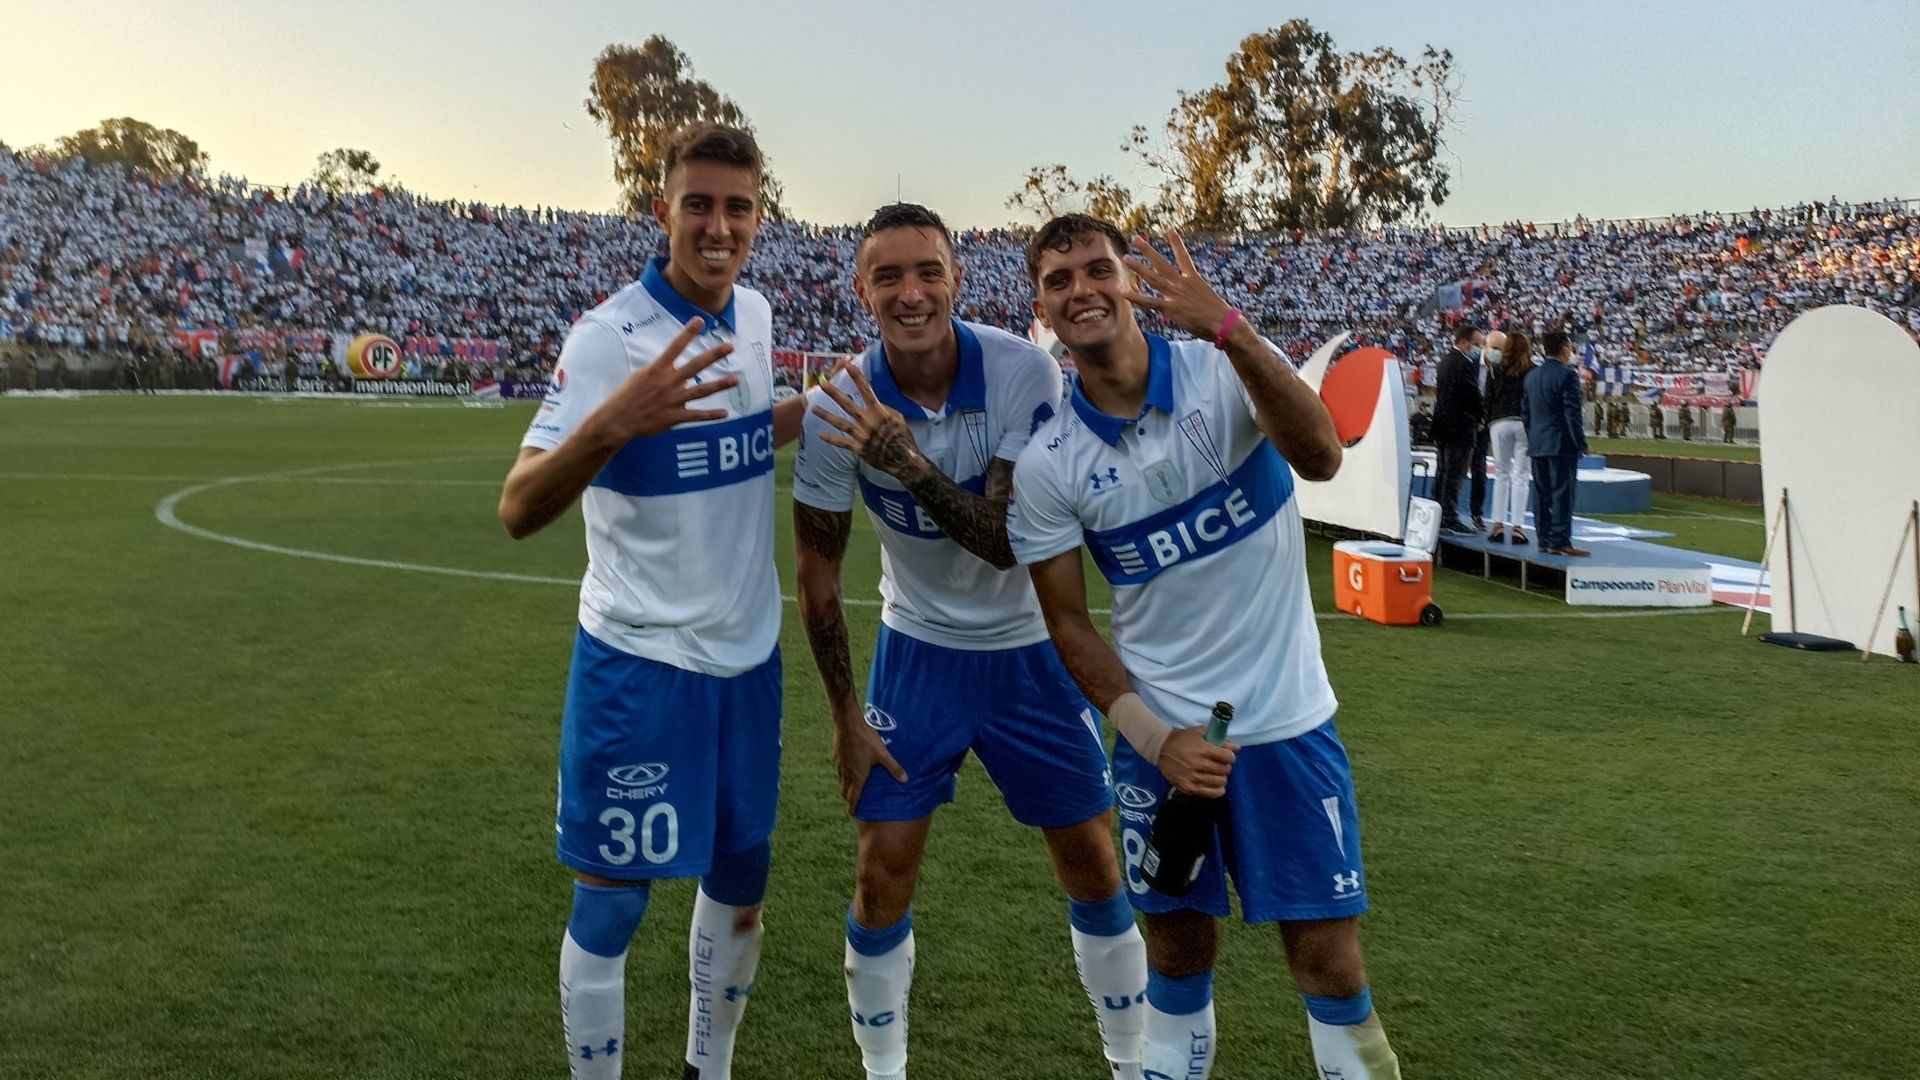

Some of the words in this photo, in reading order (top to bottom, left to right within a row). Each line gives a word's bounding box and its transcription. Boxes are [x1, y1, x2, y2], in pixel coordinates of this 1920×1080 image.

[372, 344, 395, 370] PF
[1147, 487, 1256, 567] BICE
[1348, 562, 1364, 592] G
[1570, 578, 1654, 593] Campeonato
[1658, 579, 1708, 594] PlanVital
[606, 782, 669, 800] CHERY
[598, 802, 679, 865] 30
